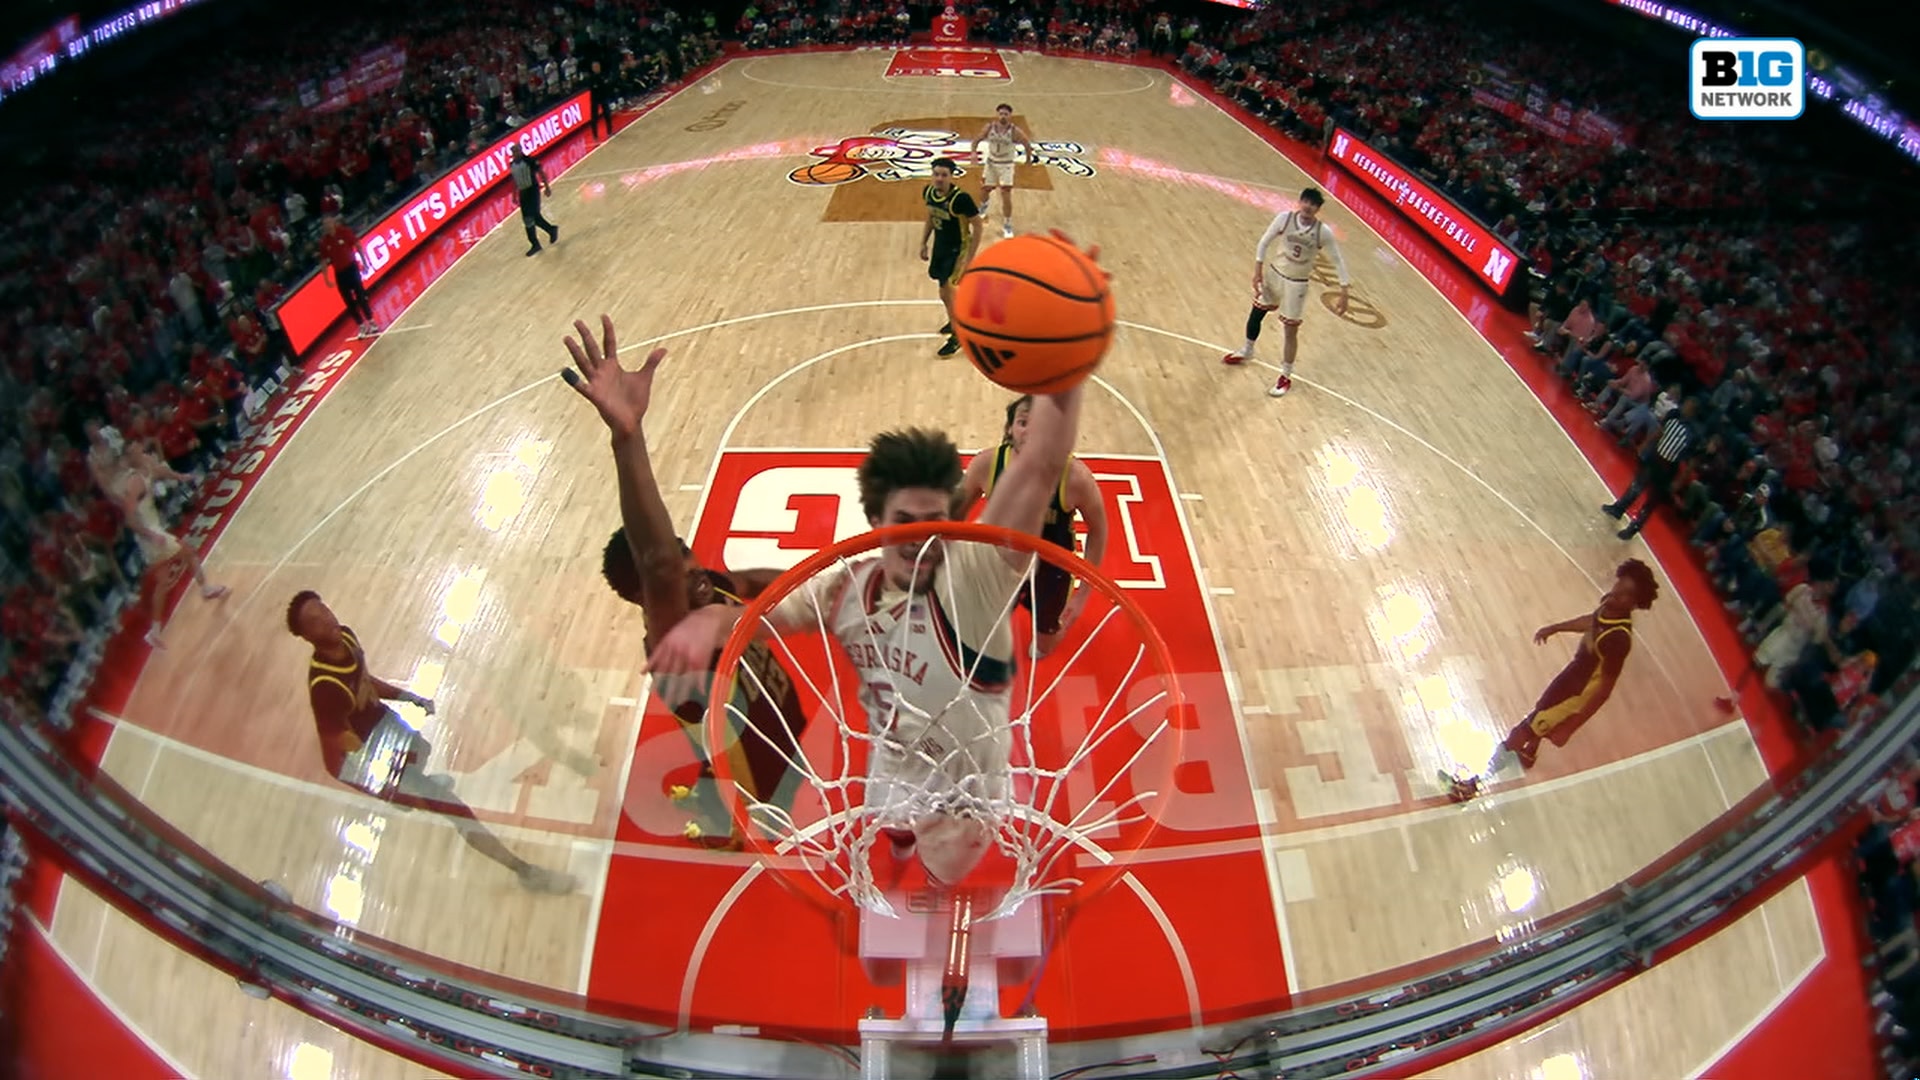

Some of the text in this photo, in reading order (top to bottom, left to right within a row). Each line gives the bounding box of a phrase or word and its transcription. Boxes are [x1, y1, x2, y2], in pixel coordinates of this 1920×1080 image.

[68, 34, 90, 57] BUY
[93, 12, 136, 43] TICKETS
[138, 1, 161, 21] NOW
[1810, 77, 1832, 99] PBA
[1844, 99, 1898, 139] JANUARY
[403, 192, 447, 241] IT'S
[450, 141, 517, 209] ALWAYS
[519, 116, 563, 157] GAME
[561, 102, 583, 130] ON
[1332, 134, 1349, 158] N
[1352, 151, 1398, 192] NEBRASKA
[1406, 191, 1479, 253] BASKETBALL
[1482, 247, 1511, 285] N
[179, 349, 354, 549] HUSKERS
